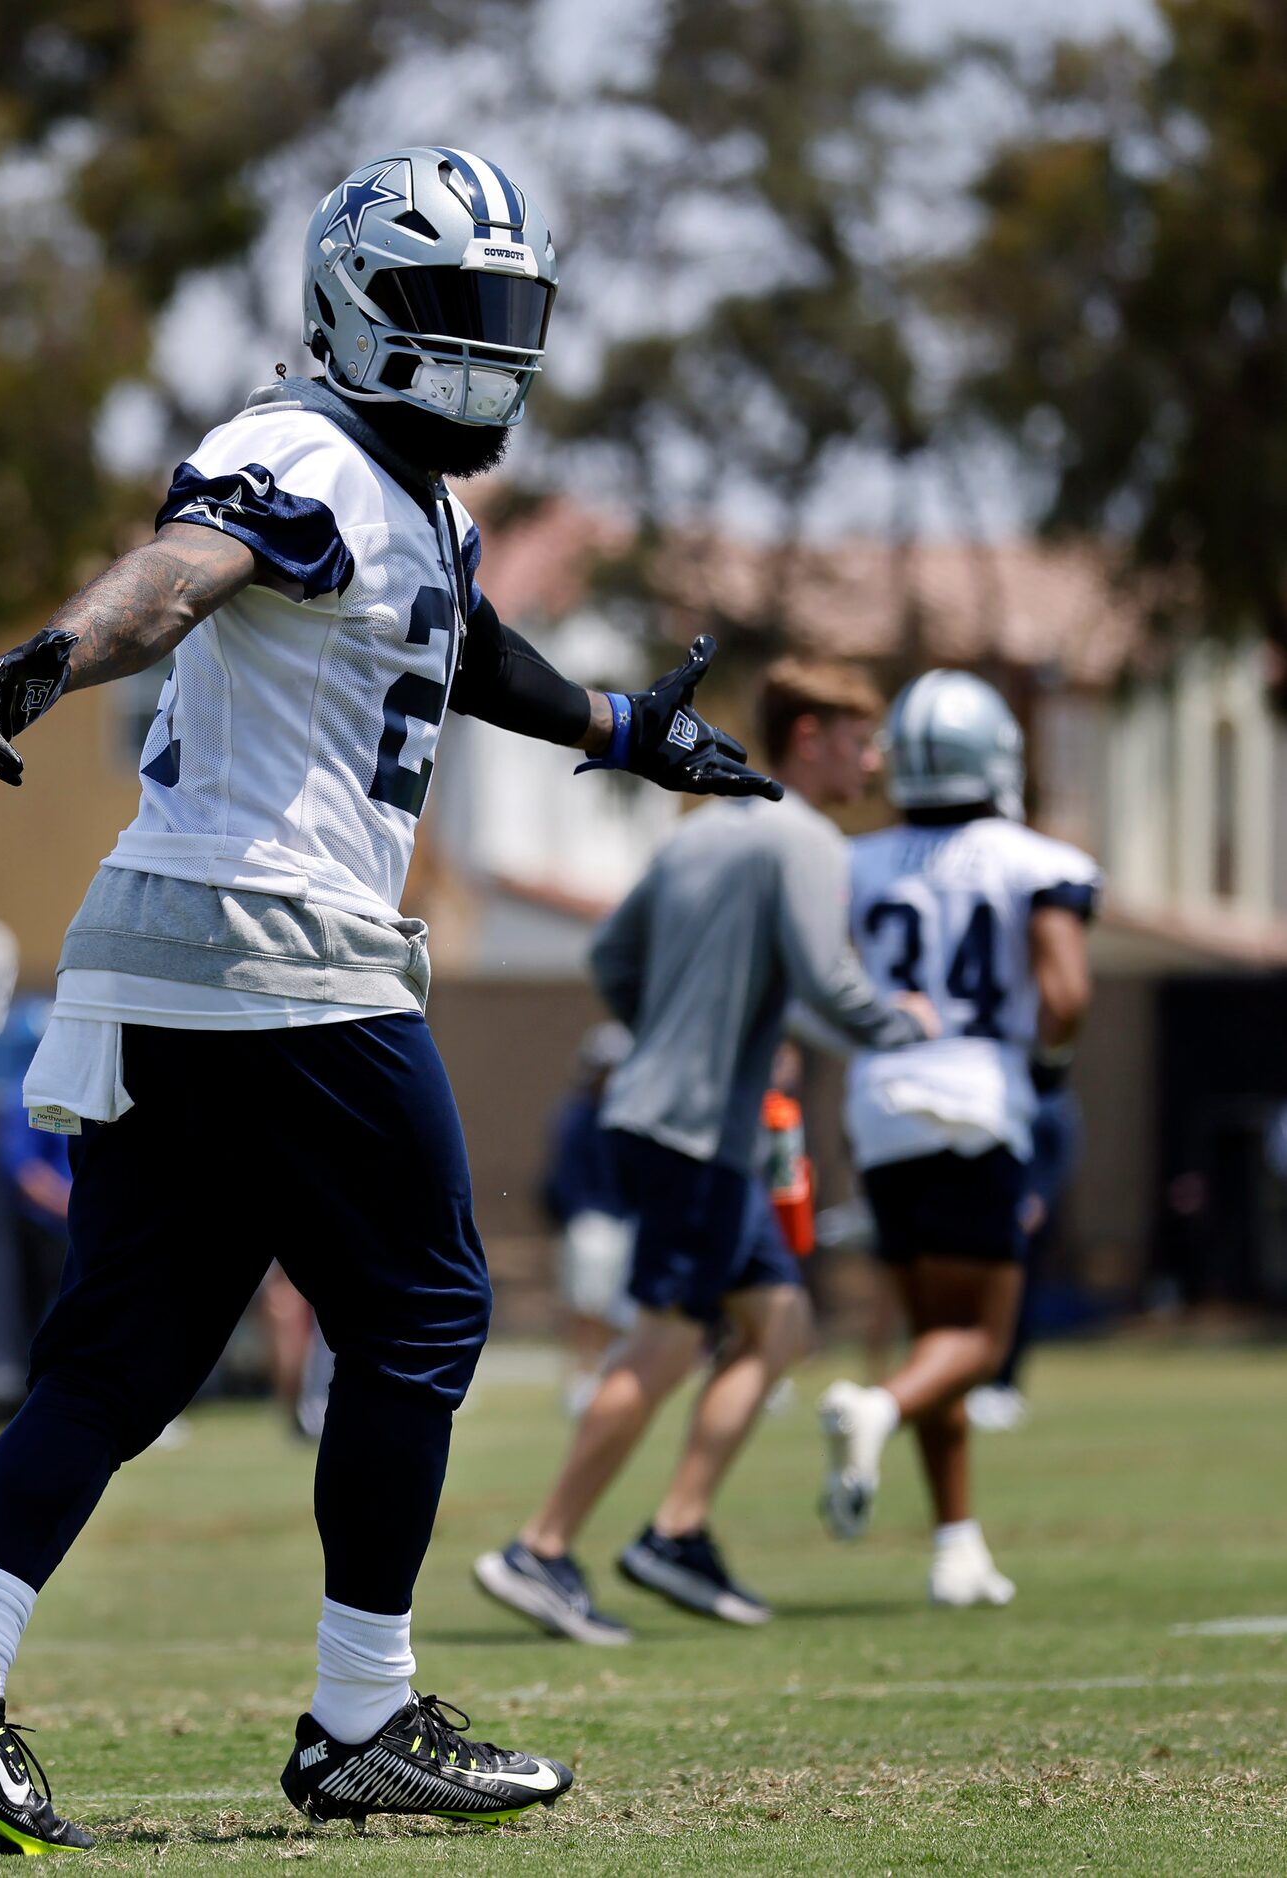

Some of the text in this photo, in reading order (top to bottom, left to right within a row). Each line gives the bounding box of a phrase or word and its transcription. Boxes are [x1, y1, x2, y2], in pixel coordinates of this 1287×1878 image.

[483, 247, 525, 261] COWBOYS
[666, 709, 699, 751] 21
[864, 899, 1007, 1039] 34
[299, 1739, 329, 1771] NIKE
